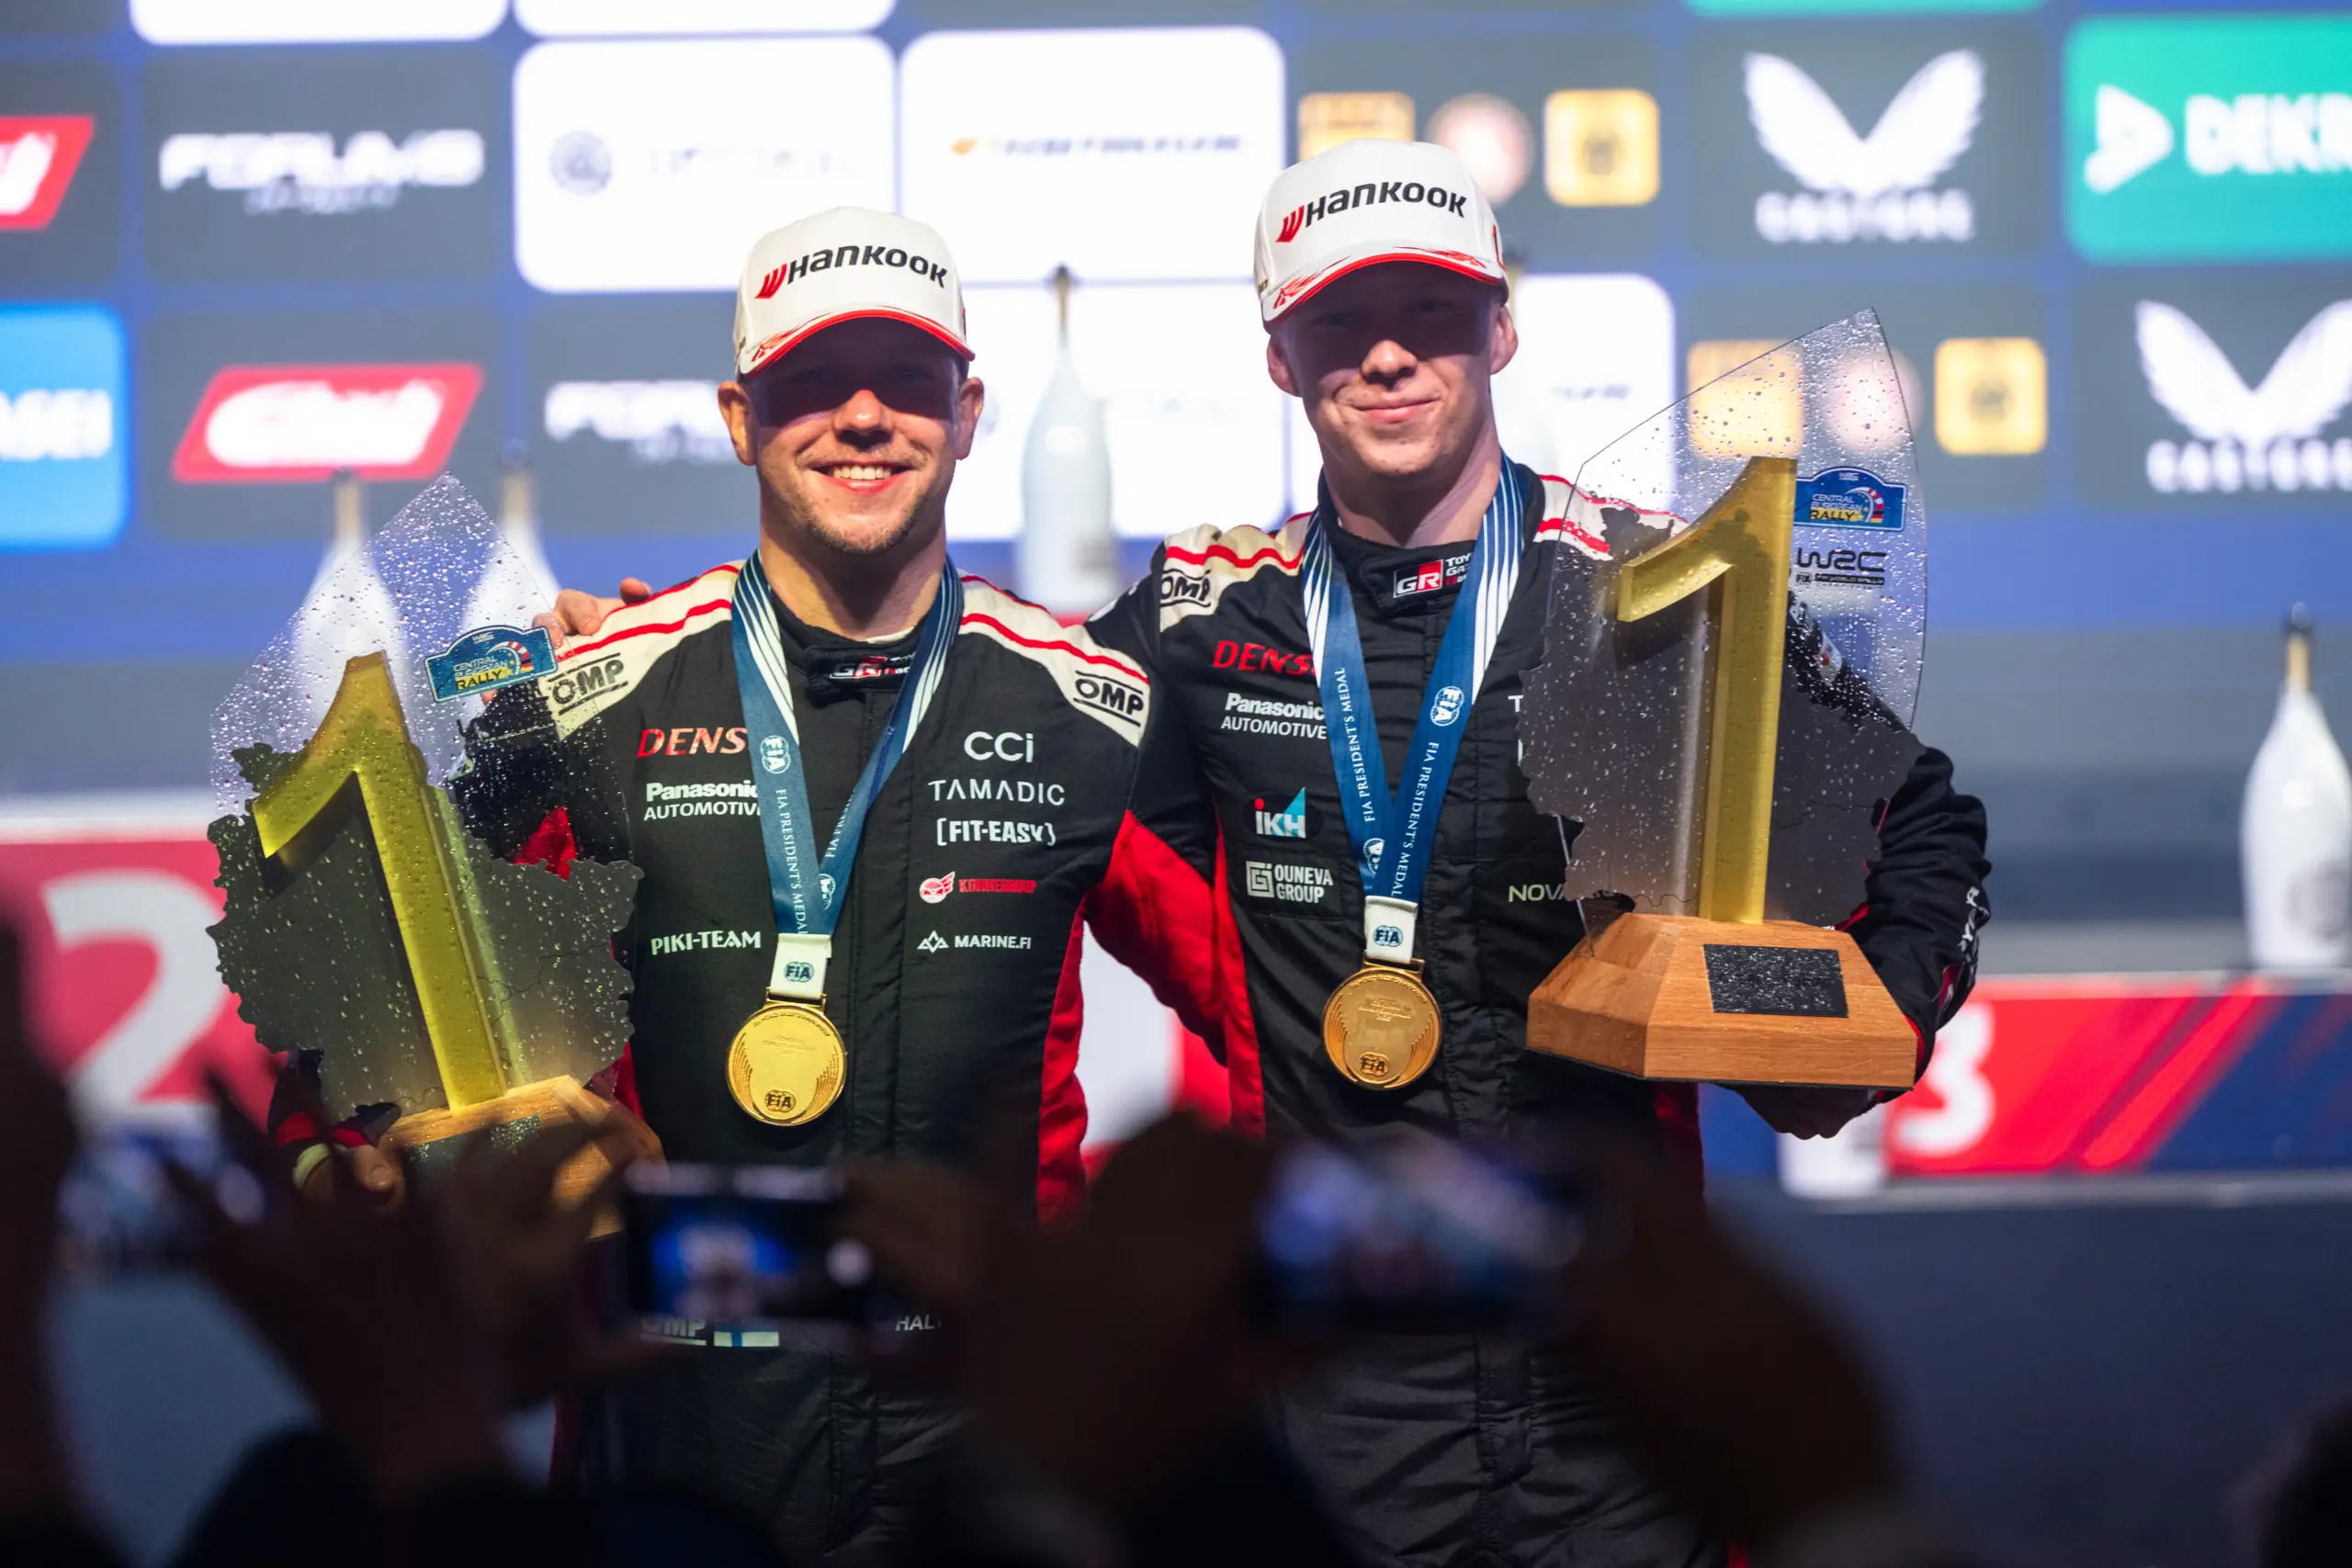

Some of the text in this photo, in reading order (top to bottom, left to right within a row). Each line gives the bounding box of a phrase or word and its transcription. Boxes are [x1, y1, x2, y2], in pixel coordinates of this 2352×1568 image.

[2185, 94, 2352, 175] DEKR
[1812, 493, 1854, 503] CENTRAL
[1809, 509, 1856, 522] RALLY
[1445, 553, 1471, 567] TOY
[1797, 547, 1887, 572] WRC
[1396, 571, 1441, 594] GR
[454, 656, 497, 671] CENTRAL
[1212, 640, 1316, 676] DENS
[456, 670, 503, 691] RALLY
[552, 659, 624, 705] OMP
[1334, 667, 1353, 712] MEDAL
[1075, 678, 1144, 716] OMP
[1225, 692, 1325, 720] Panasonic
[1432, 687, 1462, 724] FIA
[1221, 716, 1328, 739] AUTOMOTIVE
[636, 728, 748, 758] DENS
[763, 737, 788, 773] FIA
[1344, 716, 1371, 798] PRESIDENT'S
[928, 779, 1065, 807] TAMADIC
[1362, 801, 1376, 822] FIA
[1391, 741, 1440, 897] FIA PRESIDENT'S MEDAL
[779, 812, 802, 889] PRESIDENT'S
[1274, 864, 1334, 886] OUNEVA
[1275, 883, 1325, 903] GROUP
[650, 930, 762, 955] PIKI-TEAM
[954, 934, 1032, 950] MARINE.FI
[1374, 928, 1402, 945] FIA
[785, 964, 812, 980] FIA
[1360, 1055, 1387, 1074] FIA
[766, 1093, 794, 1110] FIA
[895, 1314, 942, 1332] HAL
